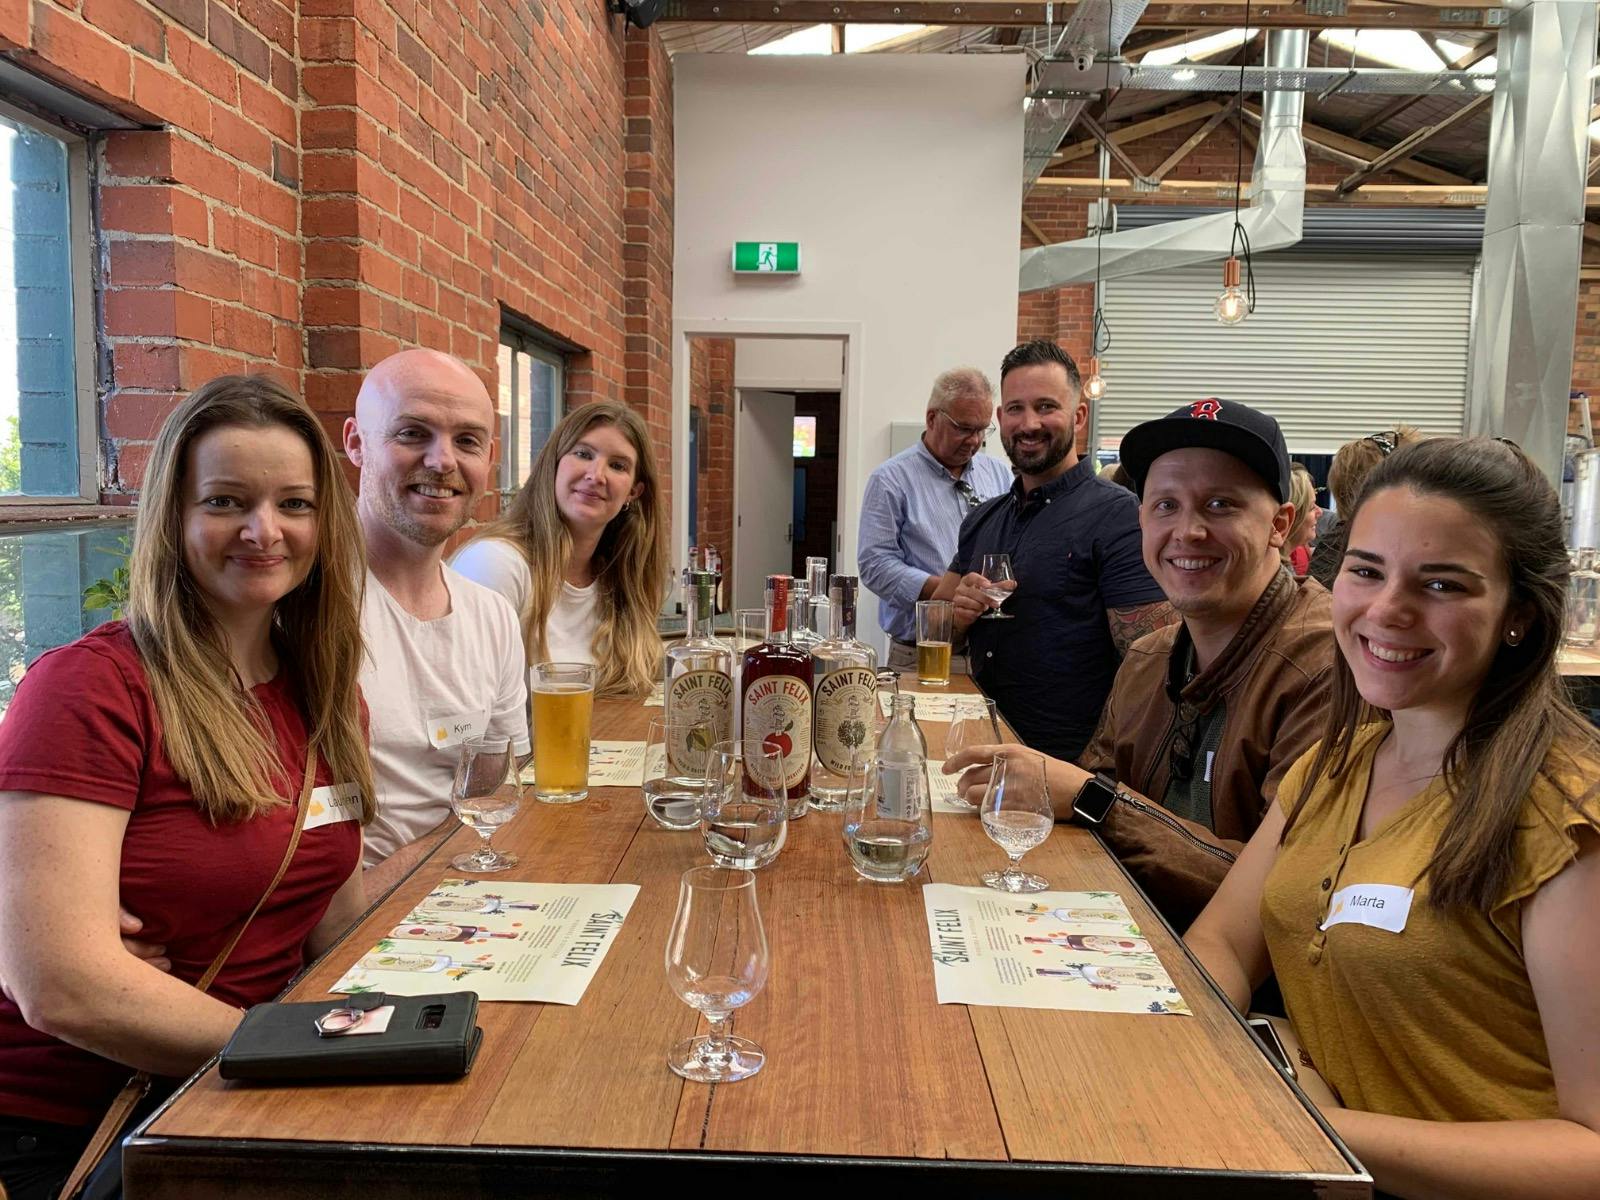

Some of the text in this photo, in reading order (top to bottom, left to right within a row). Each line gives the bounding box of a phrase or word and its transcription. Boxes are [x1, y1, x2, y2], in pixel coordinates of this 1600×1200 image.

[1190, 399, 1223, 421] B
[673, 675, 732, 700] SAINT FELIX
[748, 681, 809, 706] SAINT FELIX
[821, 672, 876, 697] SAINT FELIX
[454, 722, 472, 734] Kym
[327, 795, 359, 808] Lauen
[1349, 895, 1386, 909] Marta
[579, 912, 617, 939] SAINT
[934, 908, 970, 963] SAINT FELIX
[560, 941, 601, 968] FELIX
